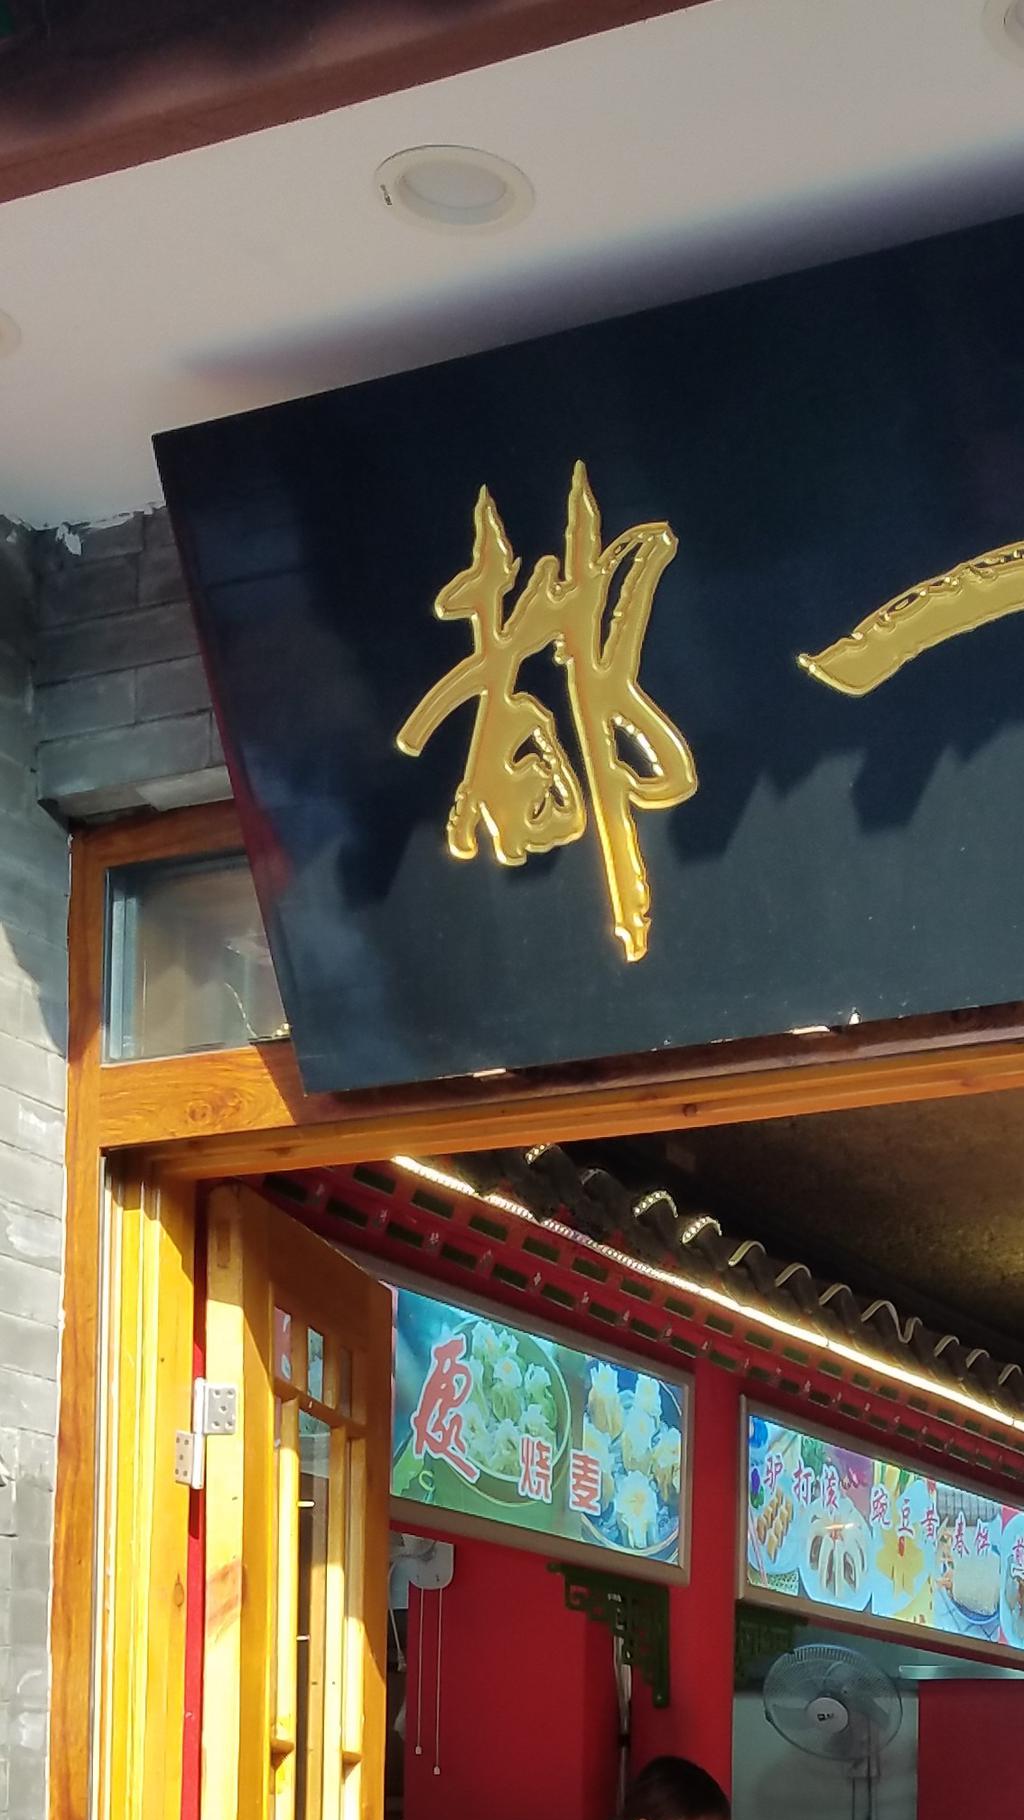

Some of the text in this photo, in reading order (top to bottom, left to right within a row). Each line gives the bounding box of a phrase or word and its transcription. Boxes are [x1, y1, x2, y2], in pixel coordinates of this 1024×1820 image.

[519, 1435, 602, 1515] 烧麦
[764, 1455, 840, 1513] 驴打滚
[871, 1486, 939, 1539] 豌豆黄
